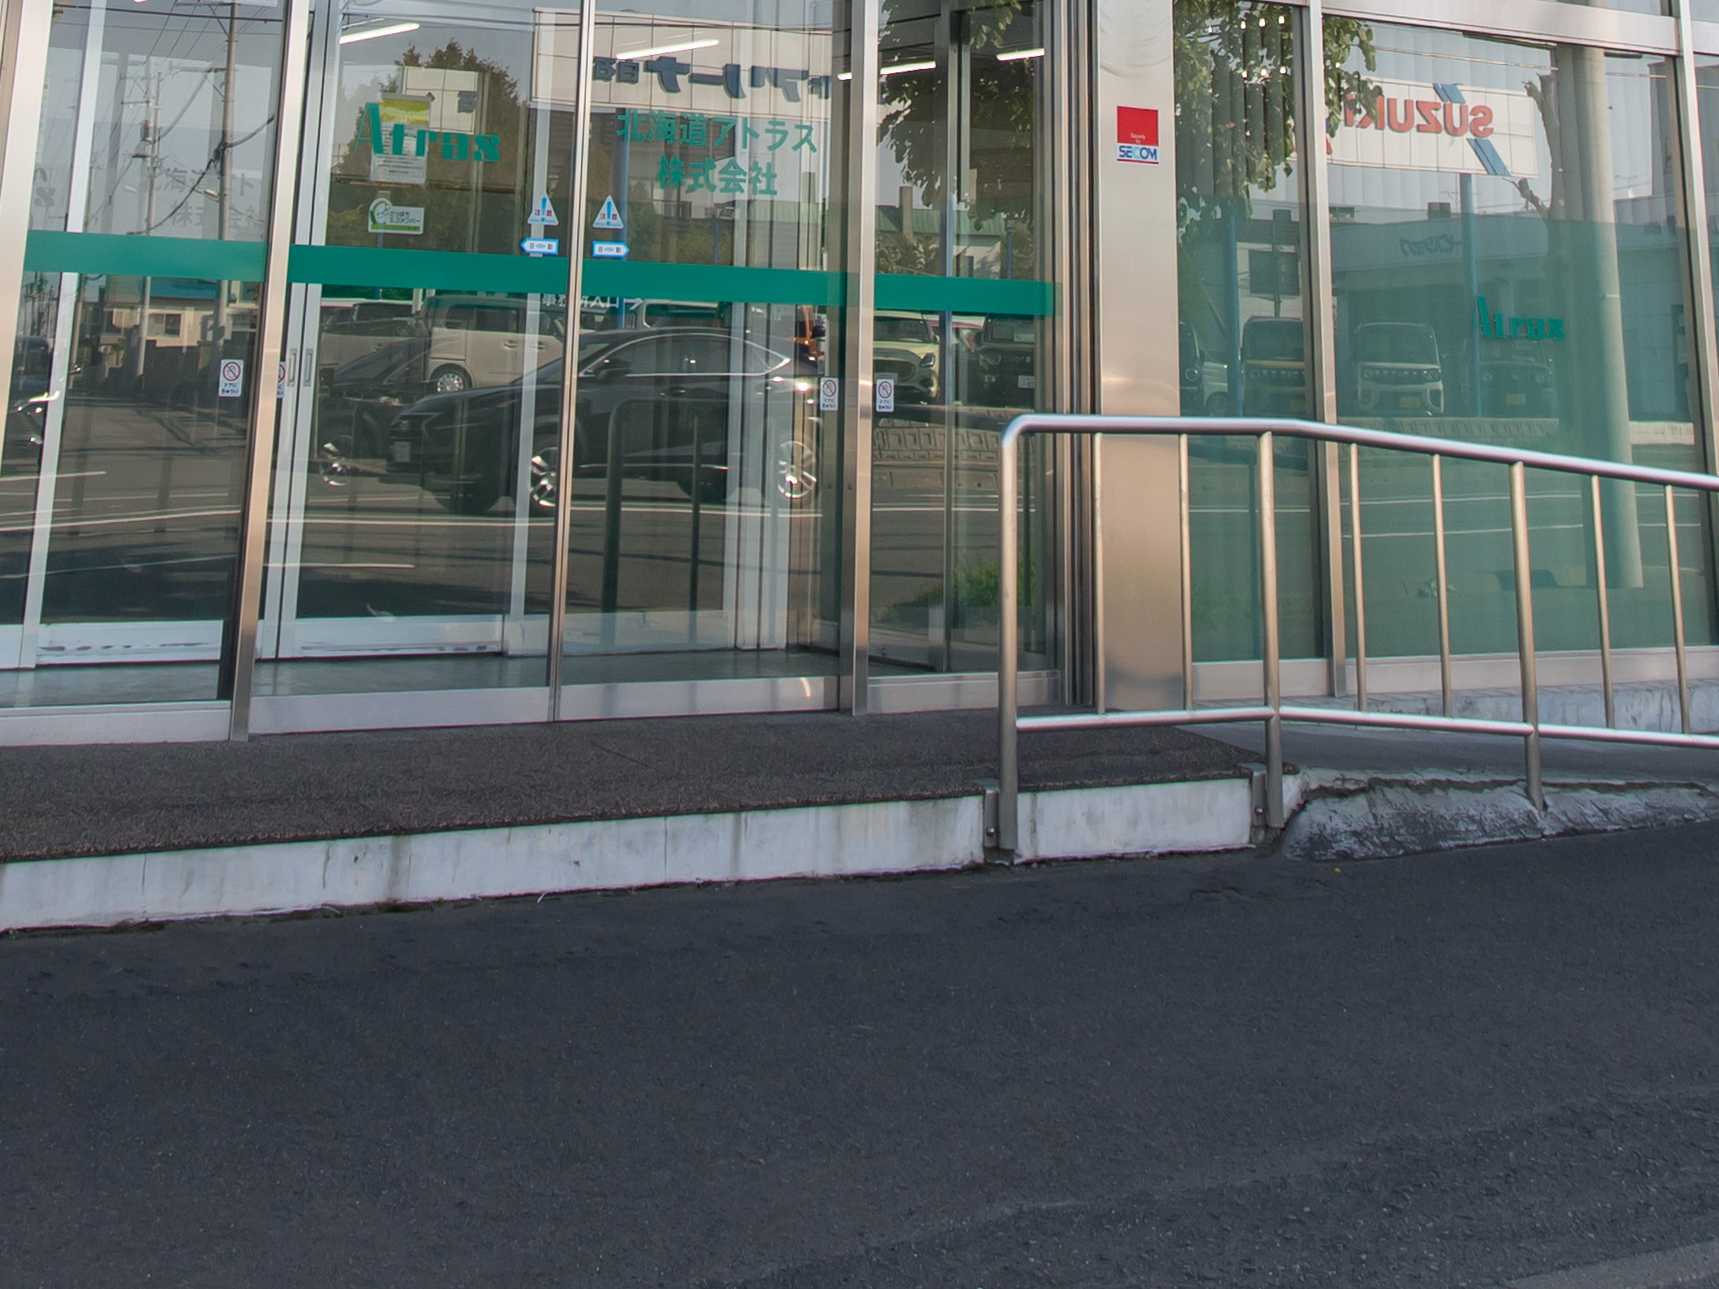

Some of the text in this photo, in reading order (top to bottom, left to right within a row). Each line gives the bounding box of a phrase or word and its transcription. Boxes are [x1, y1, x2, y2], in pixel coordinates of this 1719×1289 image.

[353, 102, 501, 163] Atras
[617, 107, 818, 154] 北海道アトラス
[1118, 145, 1158, 161] SECOM
[657, 153, 778, 196] 株式会社
